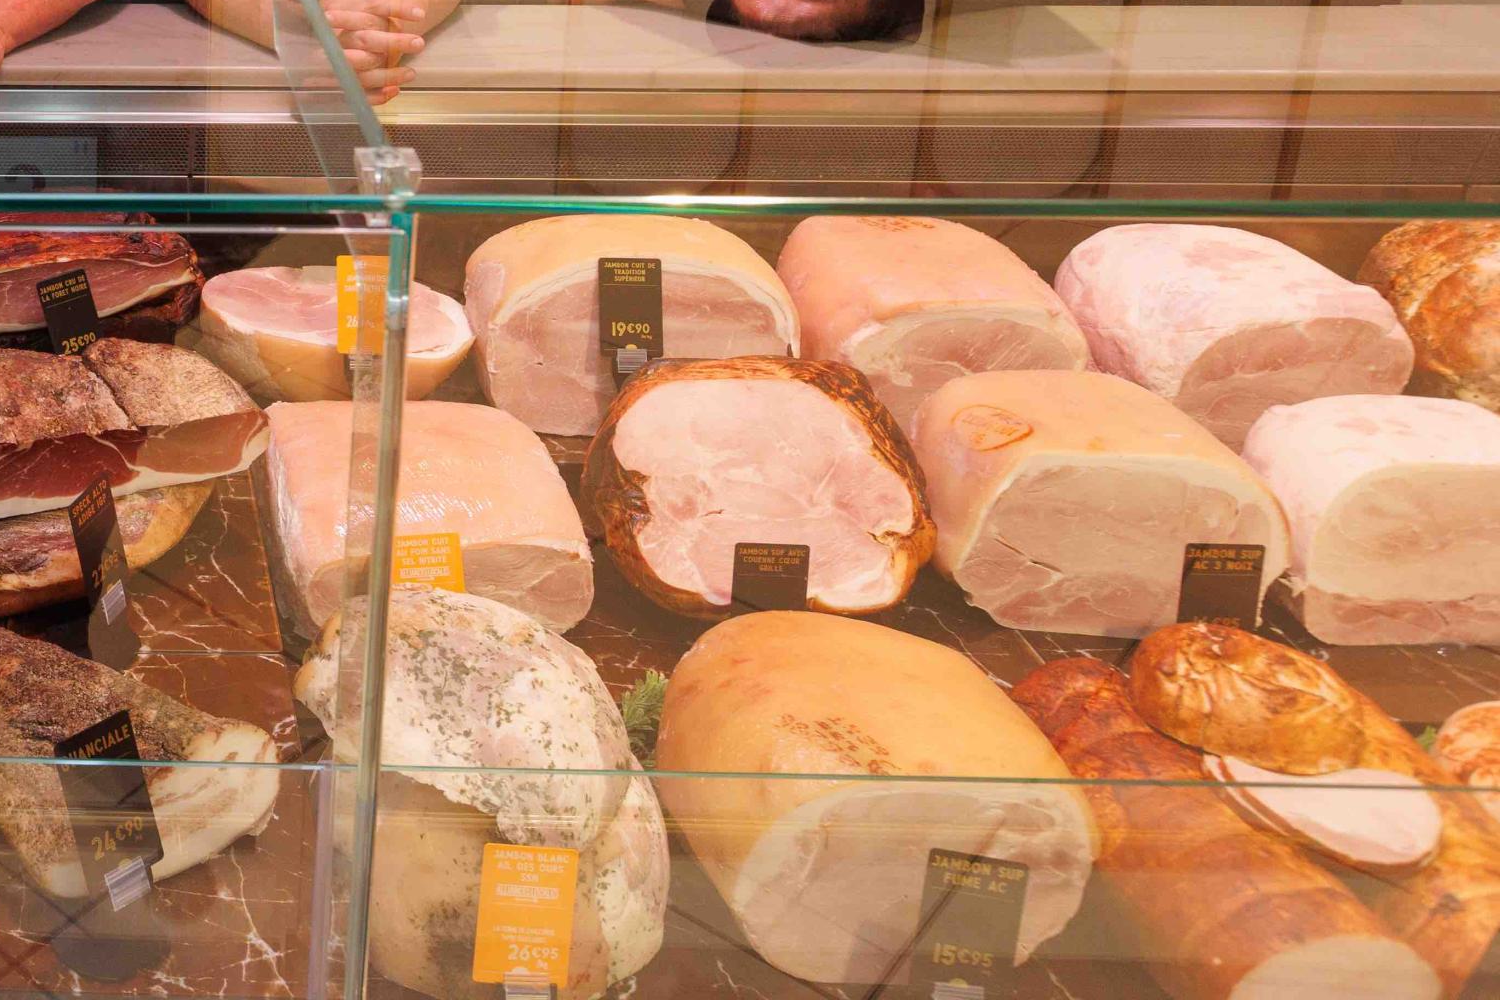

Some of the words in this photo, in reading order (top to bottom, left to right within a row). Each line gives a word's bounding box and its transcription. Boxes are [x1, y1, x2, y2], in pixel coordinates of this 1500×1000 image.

[40, 281, 64, 295] JAMBON
[64, 278, 77, 287] CRU
[41, 294, 50, 303] LA
[611, 321, 650, 337] 19€90
[61, 331, 96, 355] 25€90
[738, 547, 769, 556] JAMBON
[1187, 549, 1237, 559] JAMBON
[1193, 560, 1209, 570] AC
[1226, 560, 1253, 571] NOIX
[91, 816, 143, 861] 24€90
[494, 849, 534, 861] JAMBON
[537, 852, 569, 864] BLANC
[931, 854, 992, 876] JAMBON
[998, 866, 1025, 881] SUP
[988, 880, 1008, 893] AC
[508, 943, 559, 962] 26€95
[932, 942, 994, 968] 15€95
